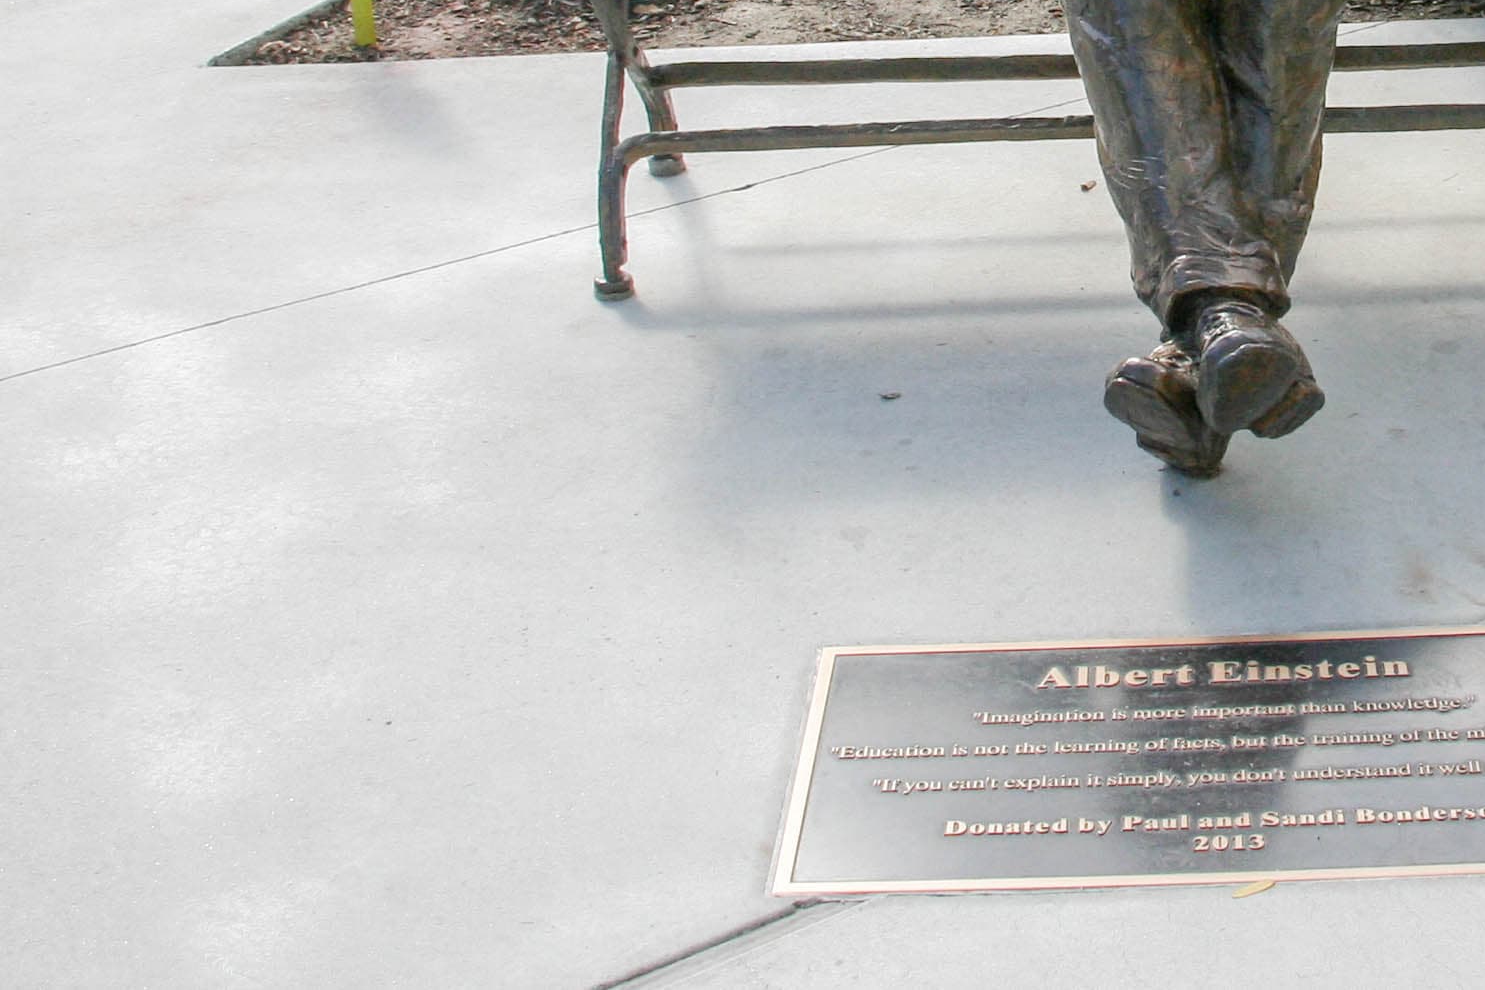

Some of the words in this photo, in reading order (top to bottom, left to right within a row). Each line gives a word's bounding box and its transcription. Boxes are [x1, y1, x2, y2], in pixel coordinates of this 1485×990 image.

[1037, 664, 1194, 689] Albert
[1208, 656, 1411, 684] Einstein
[972, 709, 1104, 726] "Imagination
[1111, 707, 1127, 721] is
[1133, 709, 1187, 721] more
[1192, 705, 1296, 720] important
[1301, 701, 1346, 715] than
[1353, 695, 1476, 714] knowledge."
[830, 743, 945, 760] "Education
[951, 742, 968, 757] is
[974, 743, 1009, 757] not
[1015, 741, 1046, 756] the
[1054, 739, 1139, 758] learning
[1145, 737, 1170, 752] of
[1173, 736, 1226, 753] facts,
[1231, 735, 1267, 749] but
[1273, 733, 1306, 747] the
[1313, 729, 1394, 746] training
[1400, 727, 1423, 742] of
[1427, 727, 1459, 741] the
[872, 778, 900, 794] "If
[901, 780, 943, 795] you
[948, 776, 999, 791] can't
[1003, 773, 1081, 793] explain
[1086, 773, 1102, 787] it
[1106, 770, 1183, 789] simply,
[1188, 772, 1228, 789] you
[1232, 768, 1286, 784] don't
[1293, 762, 1412, 781] understand
[1417, 761, 1434, 776] it
[1438, 759, 1482, 775] well
[943, 816, 1070, 838] Donated
[1078, 815, 1112, 837] by
[1122, 813, 1190, 832] Paul
[1198, 811, 1252, 830] and
[1260, 808, 1345, 828] Sandi
[1192, 833, 1266, 853] 2013
